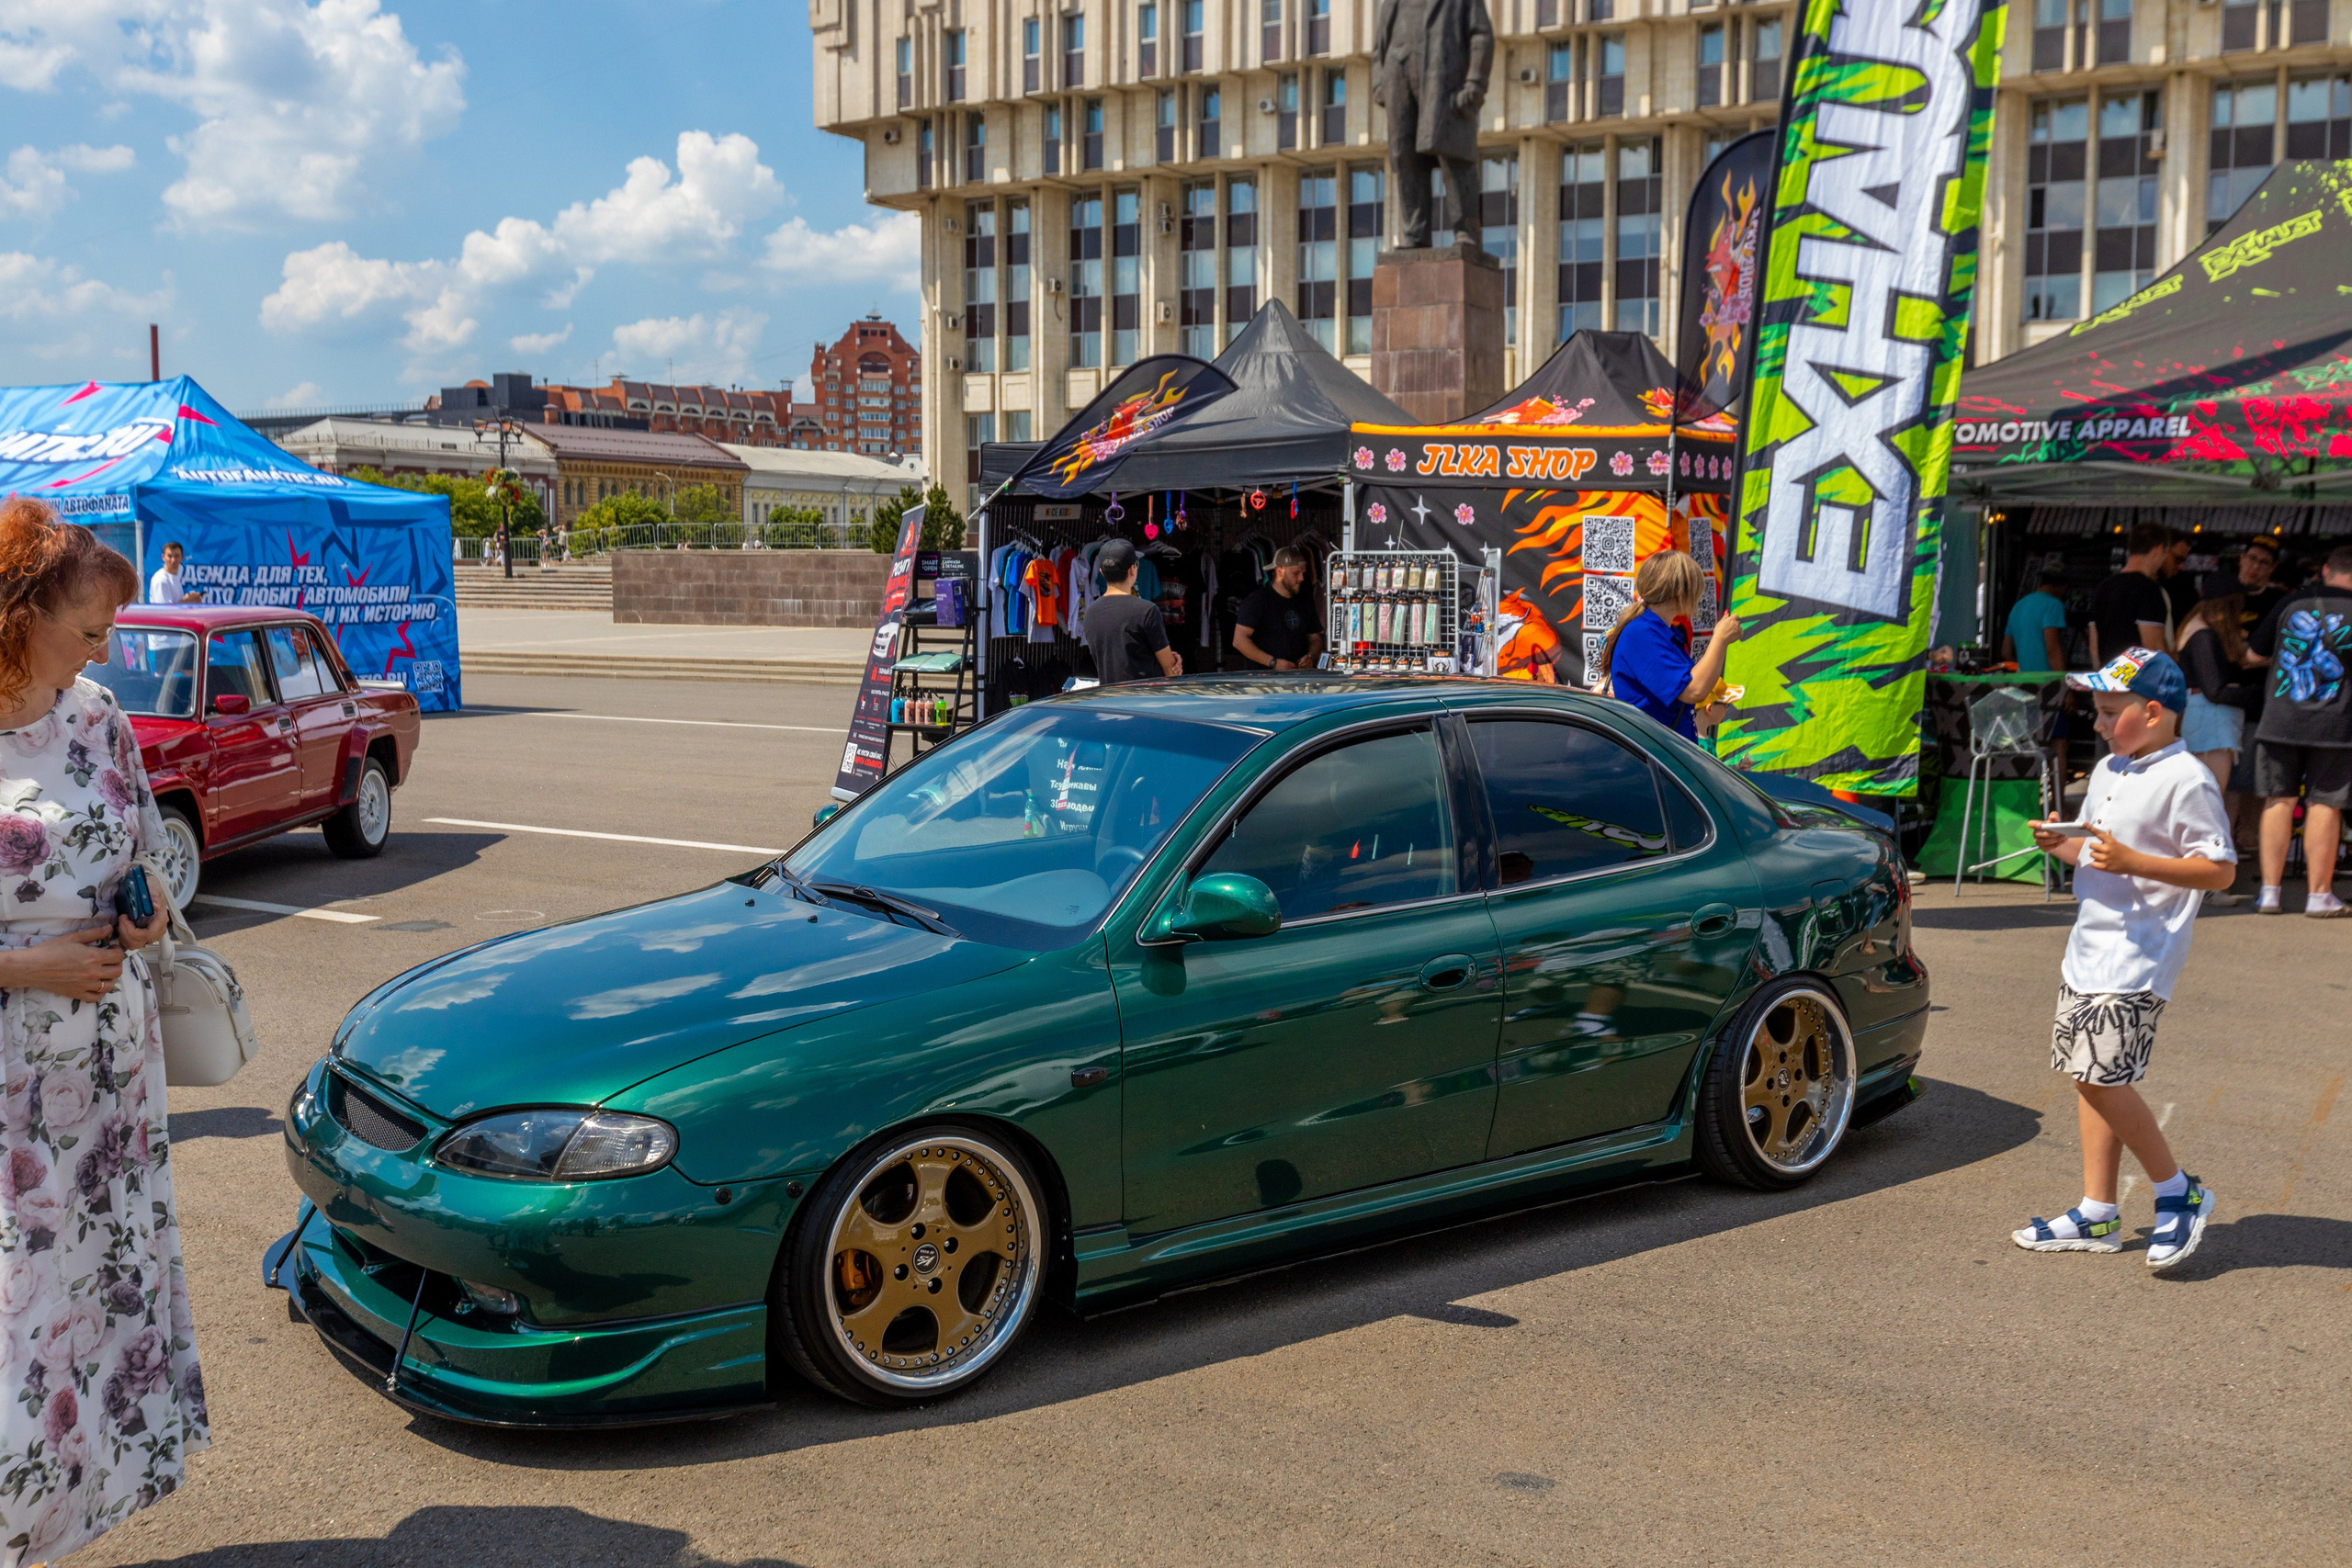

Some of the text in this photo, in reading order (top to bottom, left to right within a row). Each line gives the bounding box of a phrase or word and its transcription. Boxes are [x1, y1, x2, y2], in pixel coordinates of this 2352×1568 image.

[1758, 0, 1982, 618] EXHAU
[2076, 416, 2191, 441] APPAREL
[1416, 444, 1598, 480] JLKA SHOP
[62, 494, 130, 516] АВТОФАНАТА
[181, 565, 329, 587] ДЕЖДА ДЛЯ ТЕХ,
[238, 586, 303, 606] ЛЮБИТ
[303, 585, 411, 605] АВТОМОБИЛИ
[323, 603, 438, 624] И ИХ ИСТОРИЮ
[1049, 779, 1098, 792] Тсуикавы
